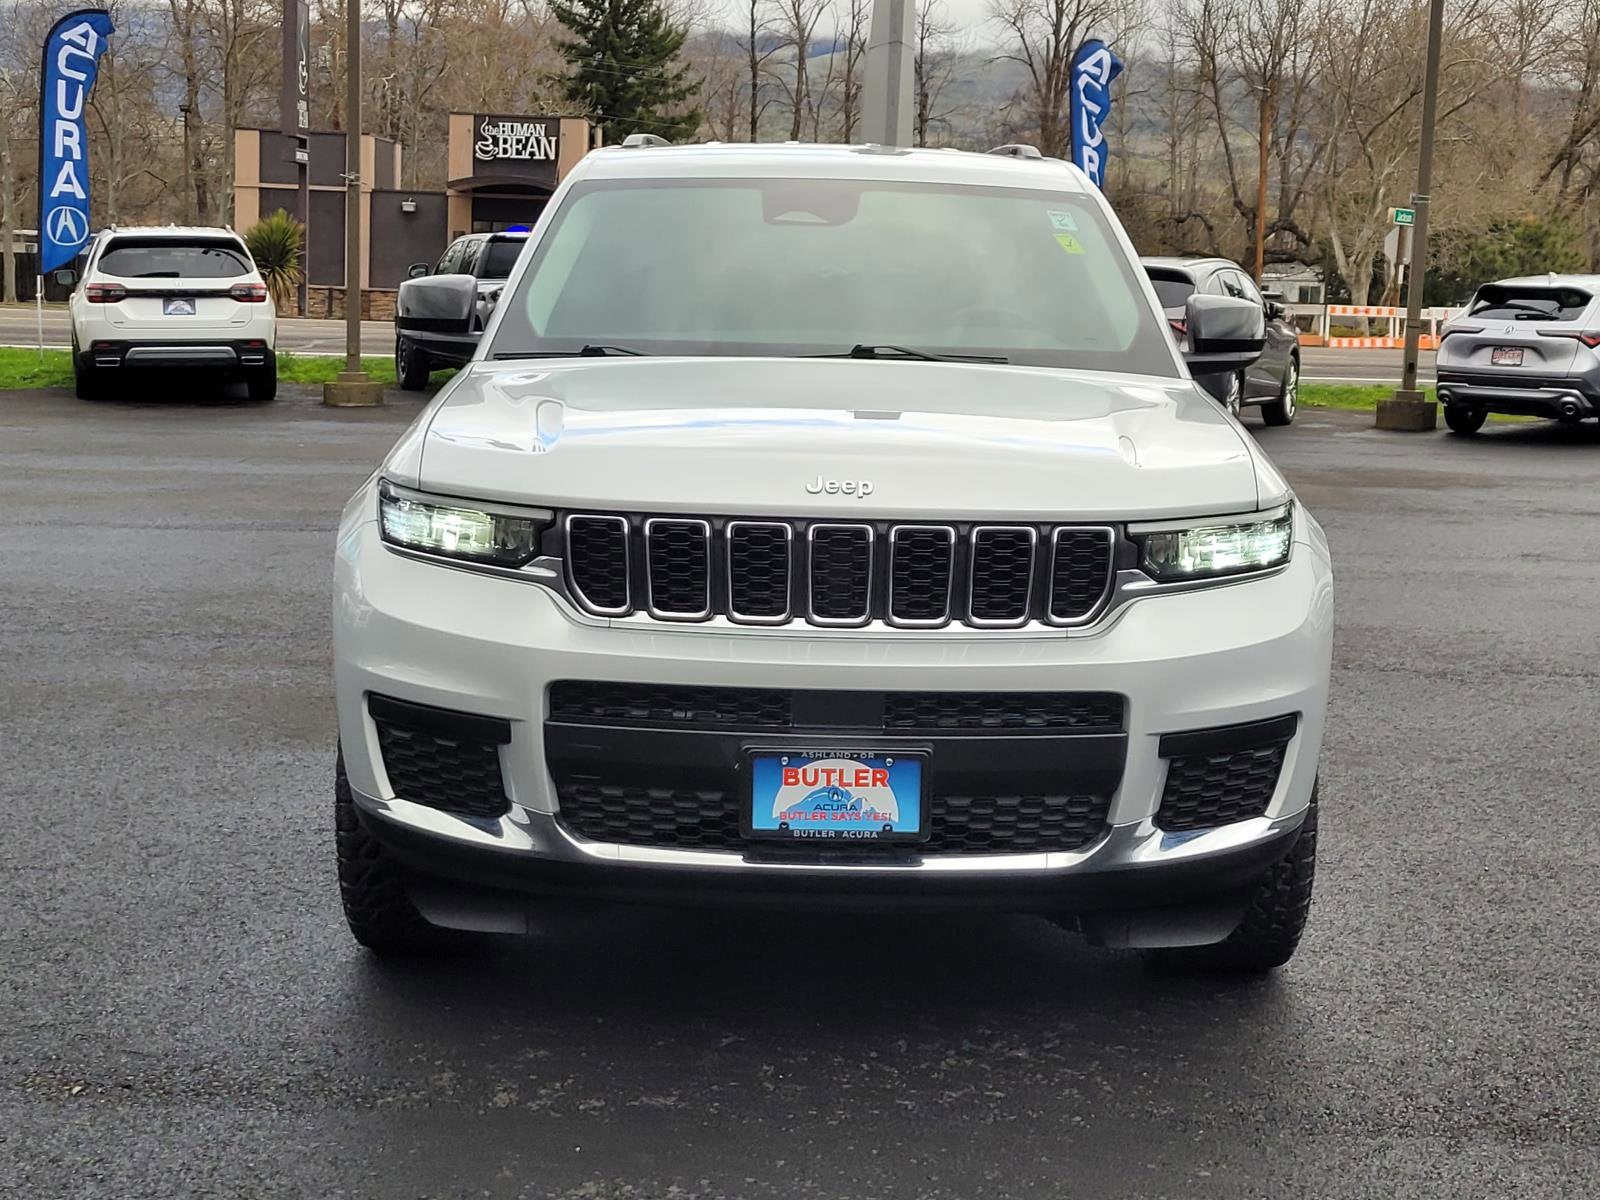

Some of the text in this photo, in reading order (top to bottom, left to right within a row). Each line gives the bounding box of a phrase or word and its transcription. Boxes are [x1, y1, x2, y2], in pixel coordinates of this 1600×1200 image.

[50, 22, 98, 199] ACURA
[1078, 49, 1112, 187] ACUR
[484, 122, 546, 137] the HUMAN
[496, 135, 557, 160] BEAN
[806, 475, 874, 499] Jeep
[801, 752, 875, 760] ASHLAND OR
[782, 767, 889, 788] BUTLER
[813, 803, 858, 811] ACURA
[779, 811, 892, 822] BUTLER SAYS YES!
[793, 829, 879, 839] BUTLER ACURA
